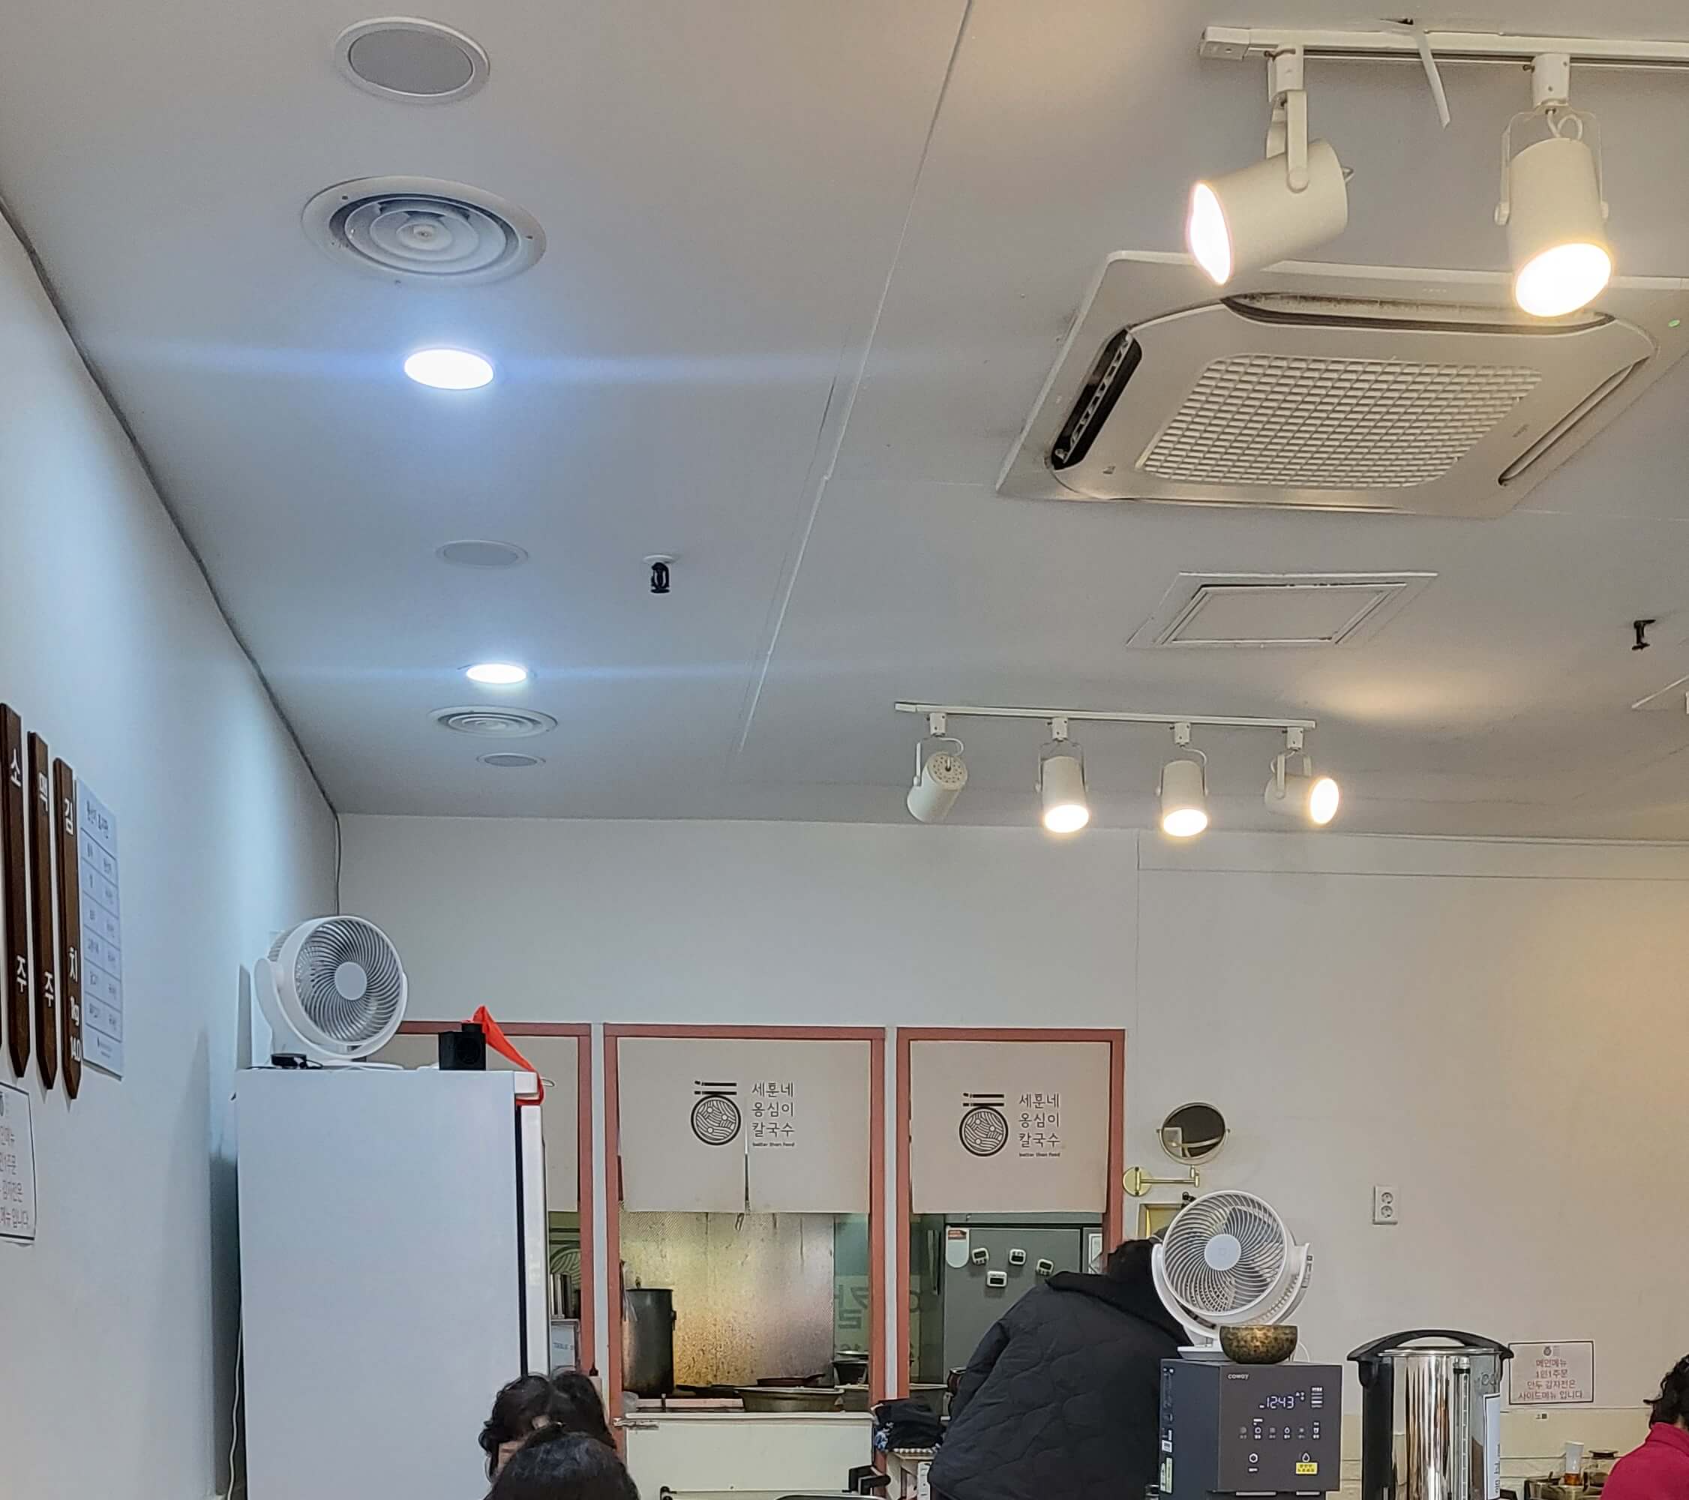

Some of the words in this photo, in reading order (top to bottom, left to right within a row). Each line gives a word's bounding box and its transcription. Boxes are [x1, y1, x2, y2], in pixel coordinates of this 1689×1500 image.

[752, 1082, 794, 1098] 세훈네
[1019, 1093, 1060, 1109] 세훈네
[752, 1101, 794, 1118] 옹심이
[1018, 1112, 1060, 1128] 옹심이
[752, 1121, 795, 1138] 칼국수
[1018, 1132, 1061, 1148] 칼국수
